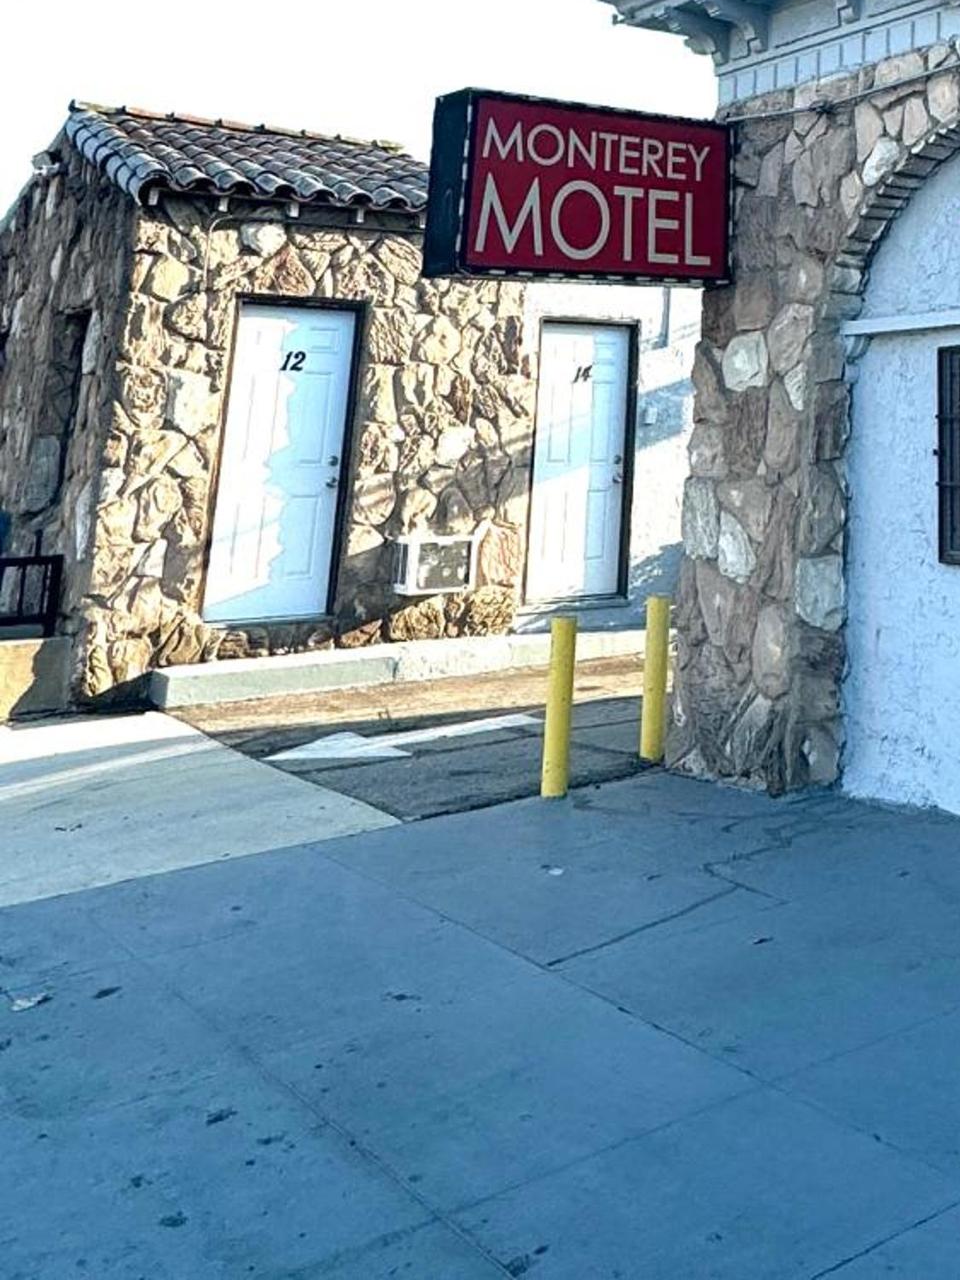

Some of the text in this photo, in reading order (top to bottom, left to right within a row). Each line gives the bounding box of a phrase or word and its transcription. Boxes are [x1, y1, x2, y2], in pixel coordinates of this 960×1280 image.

[481, 116, 711, 182] MONTEREY
[473, 171, 712, 267] MOTEL
[280, 350, 307, 372] 12
